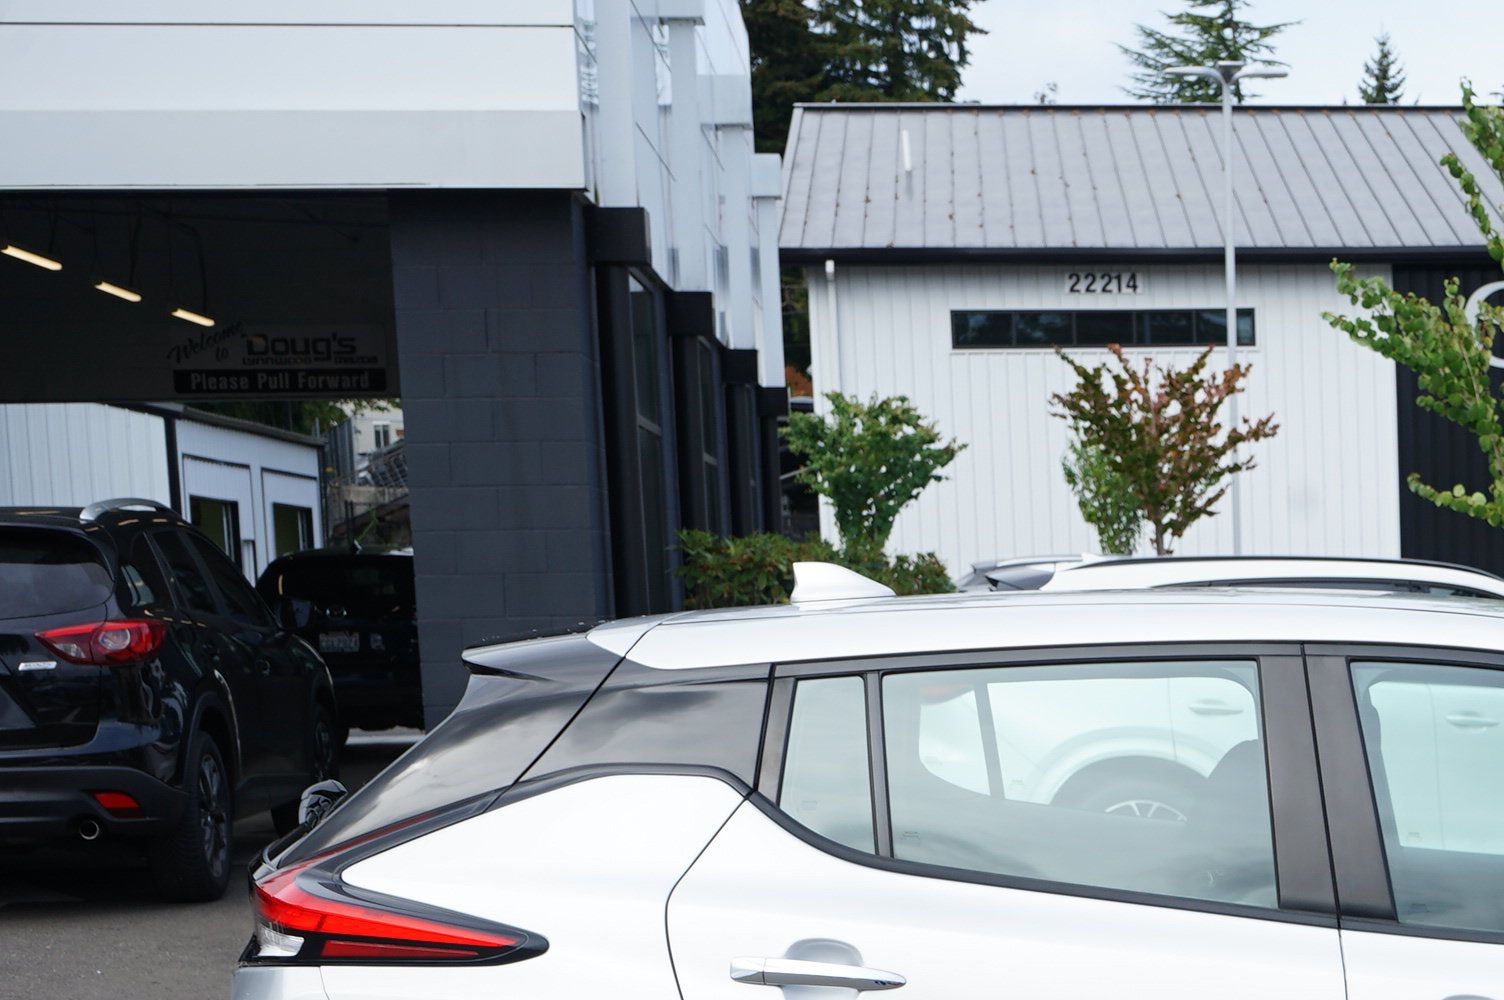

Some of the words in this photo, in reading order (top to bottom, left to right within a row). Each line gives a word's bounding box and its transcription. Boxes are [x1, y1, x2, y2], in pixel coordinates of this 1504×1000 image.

[1068, 272, 1138, 294] 22214
[247, 332, 357, 361] Doug's
[190, 372, 250, 390] Please
[257, 372, 289, 390] Pull
[298, 371, 370, 390] Forward
